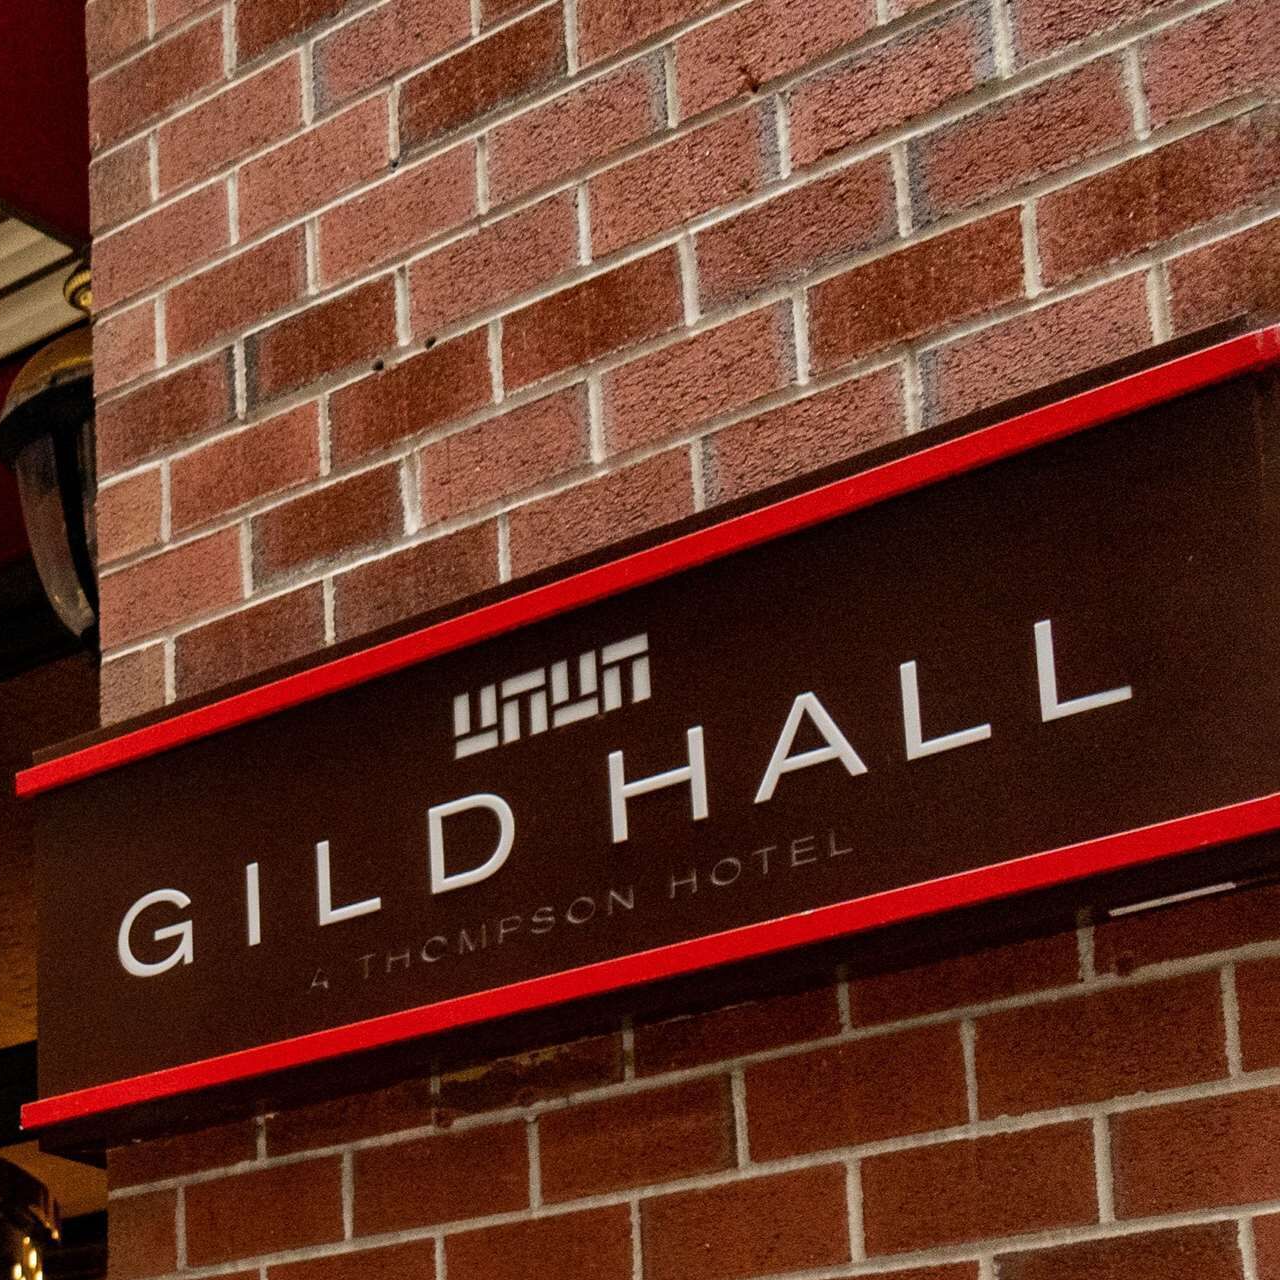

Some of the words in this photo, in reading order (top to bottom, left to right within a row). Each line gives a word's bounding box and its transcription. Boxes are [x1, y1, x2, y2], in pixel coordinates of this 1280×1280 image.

[116, 791, 517, 978] GILD
[607, 618, 1134, 844] HALL
[354, 885, 636, 980] THOMPSON
[668, 828, 854, 899] HOTEL
